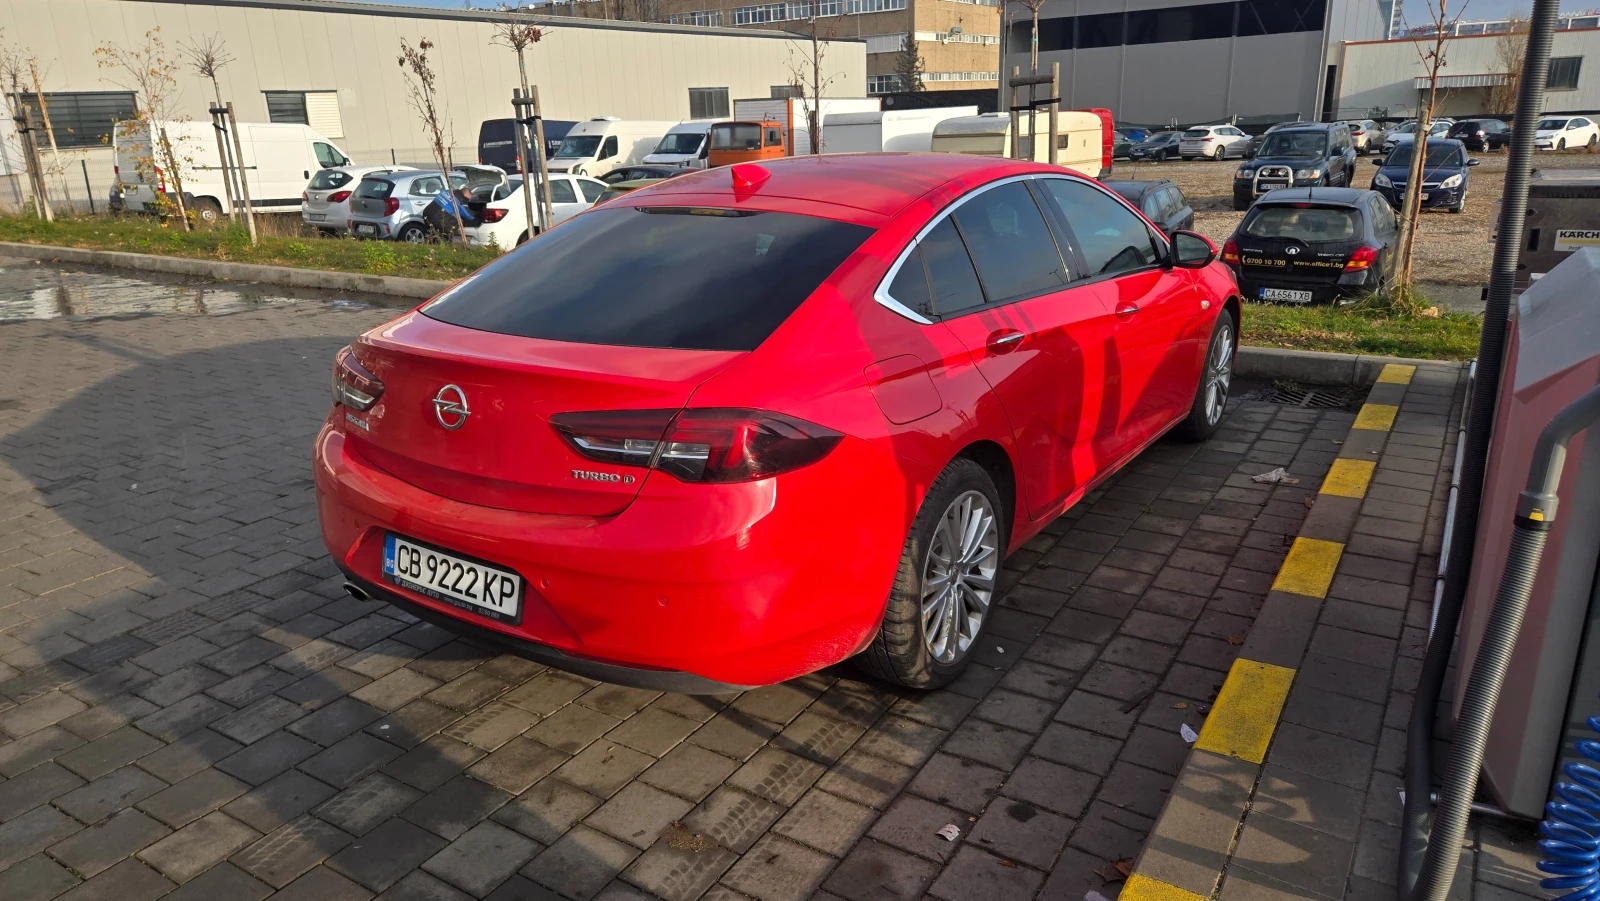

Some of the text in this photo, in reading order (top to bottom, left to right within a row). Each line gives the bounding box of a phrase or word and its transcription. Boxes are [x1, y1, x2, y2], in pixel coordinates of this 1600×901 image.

[1293, 259, 1344, 268] www.office1.bg
[1265, 289, 1276, 298] CA
[1277, 291, 1297, 299] 6561
[1298, 292, 1310, 300] XB
[571, 469, 621, 483] TURBO
[386, 557, 395, 569] BG
[397, 544, 515, 608] CB 9222 KP
